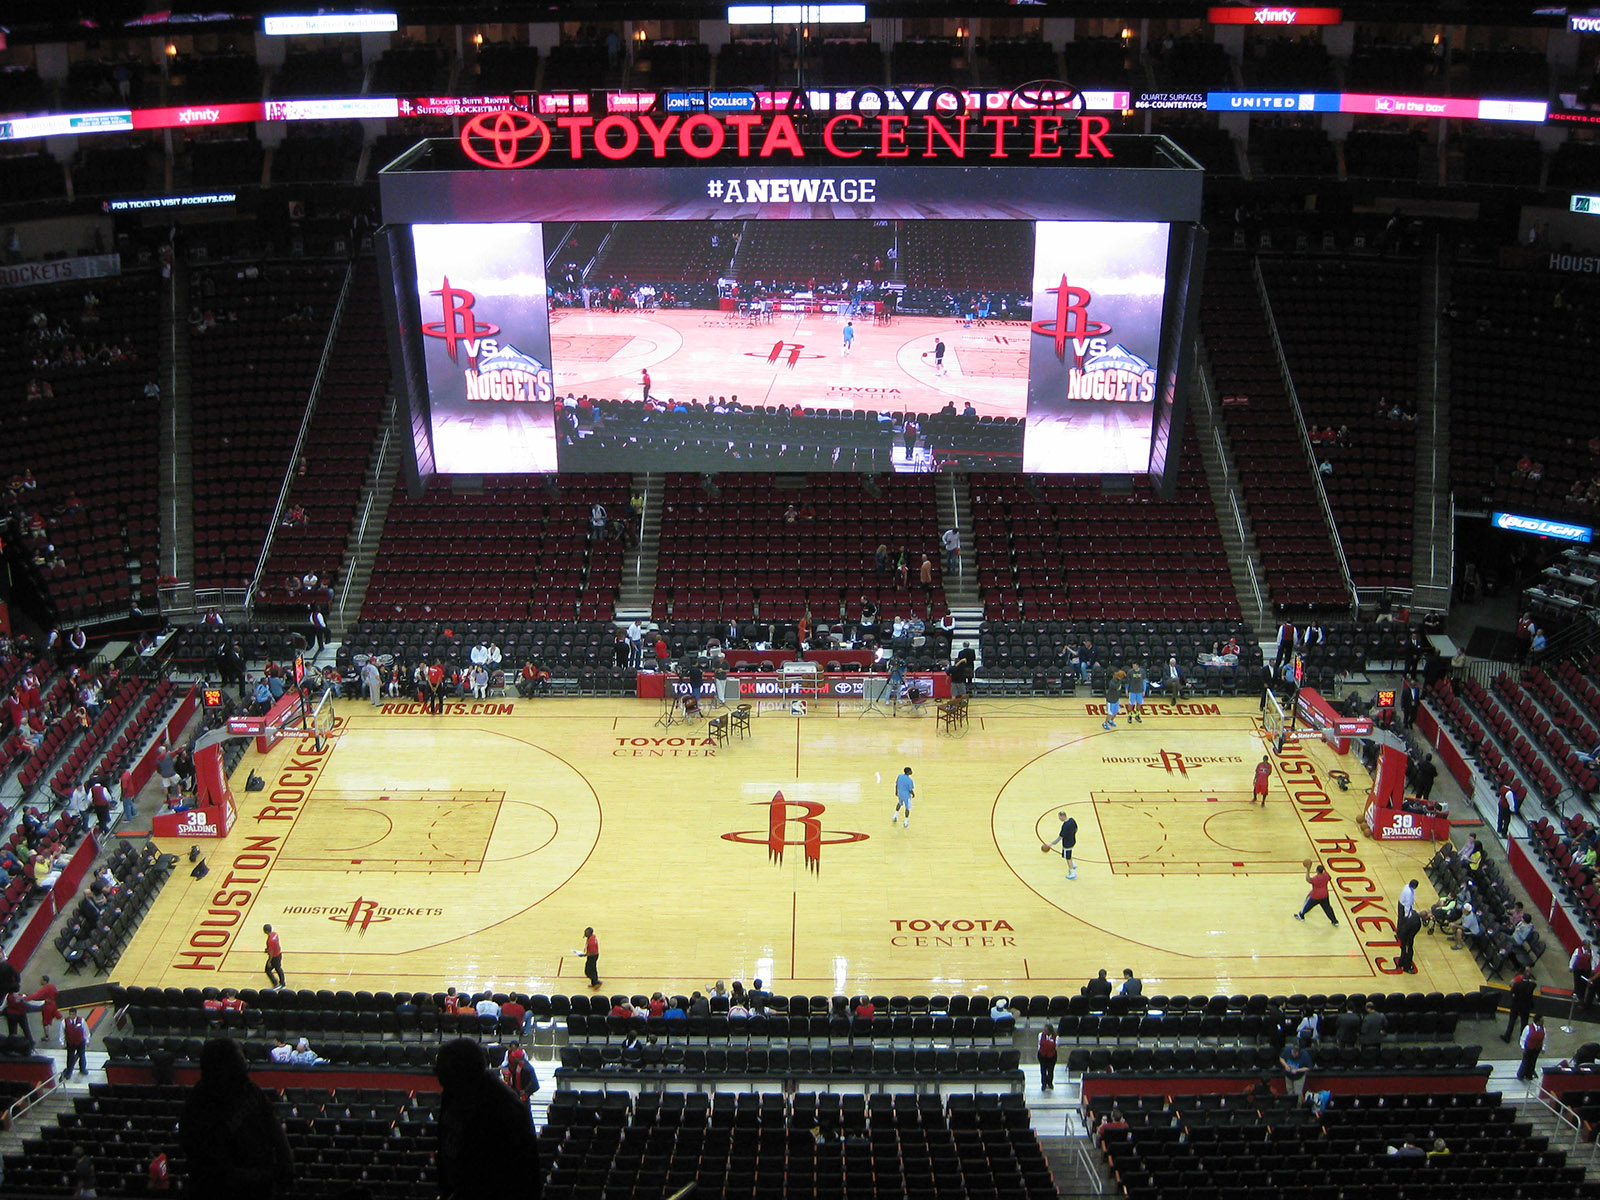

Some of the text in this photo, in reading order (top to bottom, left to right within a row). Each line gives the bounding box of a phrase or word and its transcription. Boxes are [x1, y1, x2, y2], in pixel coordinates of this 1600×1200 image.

[1253, 8, 1296, 24] xfinity
[710, 97, 748, 106] COLLEGE
[1140, 93, 1203, 101] QUARTZ SURFACES
[1231, 97, 1296, 108] UNITED
[1135, 101, 1208, 109] 866-COUNTERTOPS
[179, 109, 219, 124] xfinity
[557, 114, 1115, 160] TOYOTA CENTER
[112, 194, 236, 210] FOR TICKETS VISIT ROCKETS.COM
[463, 339, 499, 358] VS
[1072, 338, 1108, 357] VS
[465, 369, 553, 403] NUGGETS
[1067, 369, 1155, 403] NUGGETS
[1538, 523, 1585, 538] LIGHT
[1380, 698, 1391, 706] 24
[616, 737, 717, 747] TOYOTA
[613, 749, 717, 757] CENTER
[1102, 756, 1160, 764] HOUSTON
[1185, 756, 1243, 764] ROCKETS
[187, 812, 207, 826] 30
[1393, 814, 1413, 828] 30
[178, 823, 217, 835] SPALDING
[1382, 826, 1422, 837] SPALDING
[173, 836, 280, 970] HOUSTON
[283, 905, 349, 915] HOUSTON
[377, 907, 444, 916] ROCKETS
[889, 919, 1015, 932] TOYOTA
[890, 935, 1017, 948] CENTER
